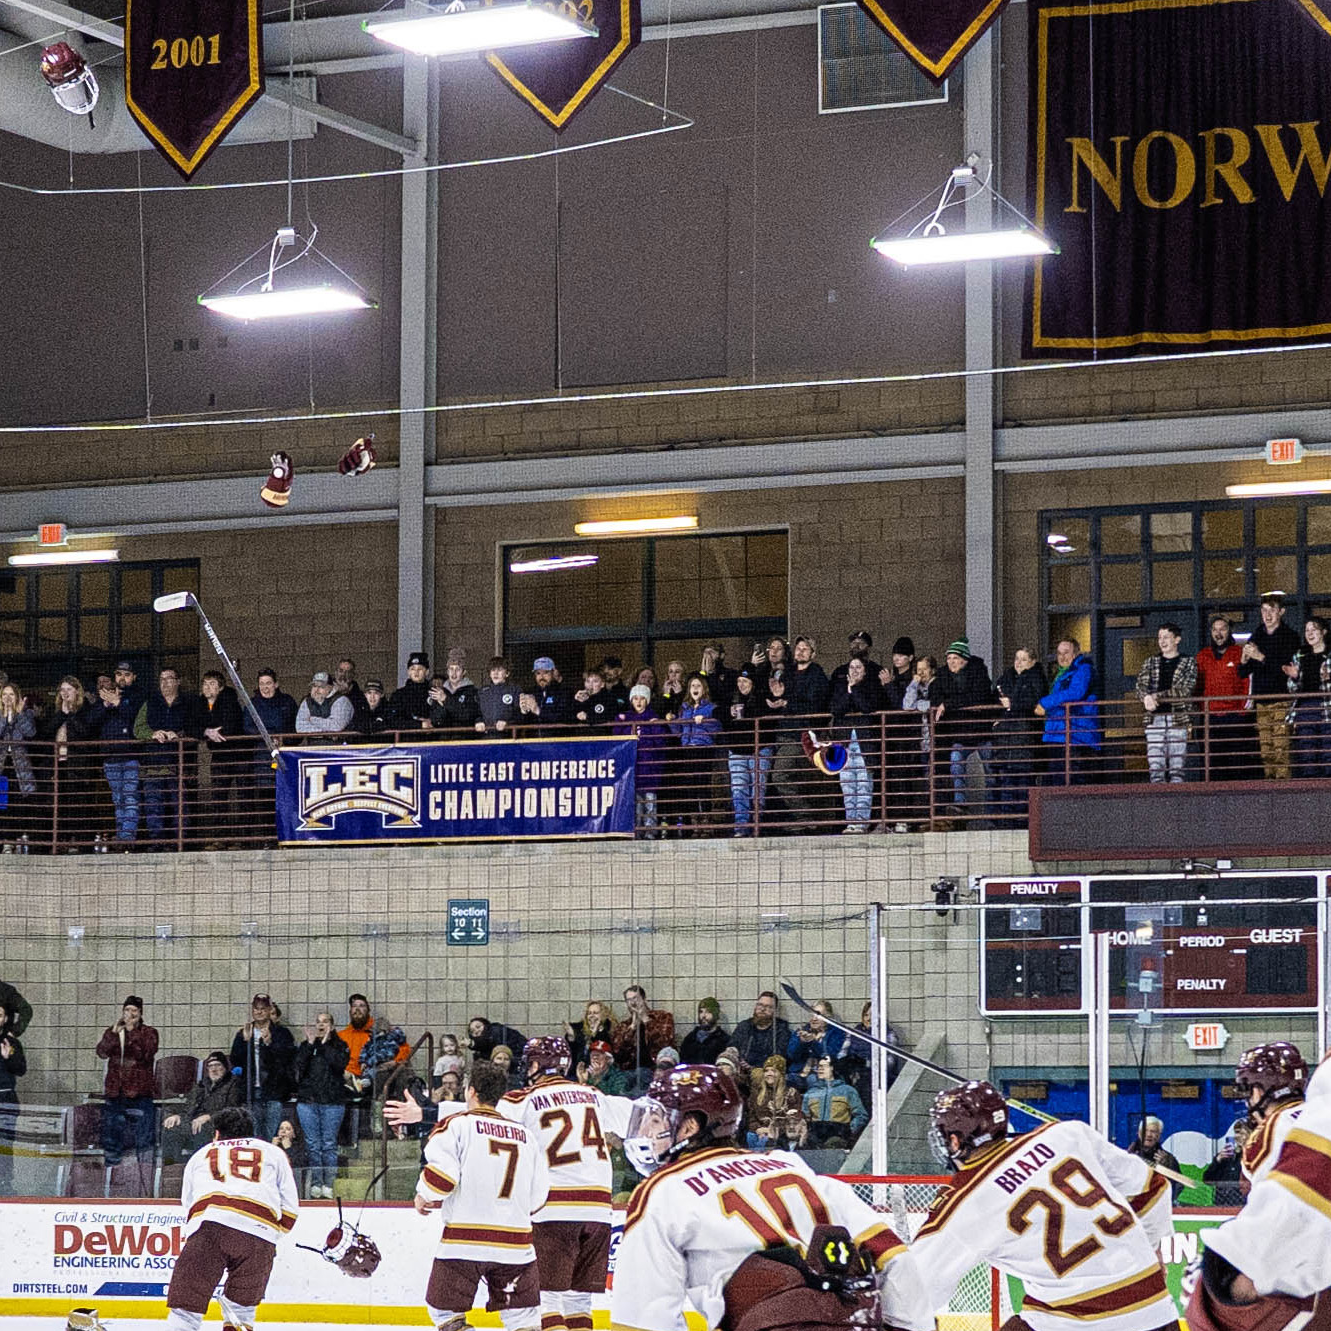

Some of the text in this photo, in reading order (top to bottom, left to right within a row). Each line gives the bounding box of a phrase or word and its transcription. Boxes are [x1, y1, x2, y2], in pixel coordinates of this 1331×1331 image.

[151, 34, 221, 70] 2001
[1272, 442, 1295, 461] EXIT
[430, 759, 615, 783] LITTLE EAST CONFERENCE
[306, 764, 413, 804] LEC
[429, 786, 615, 820] CHAMPIONSHIP
[1011, 883, 1058, 896] PENALTY
[451, 907, 486, 916] Section
[454, 918, 482, 927] 10 11
[1109, 931, 1151, 945] HOME
[1180, 935, 1224, 948] PERIOD
[1250, 928, 1303, 943] GUEST
[1177, 979, 1226, 991] PENALTY
[1194, 1026, 1219, 1047] EXIT
[532, 1095, 551, 1110] VAN
[476, 1120, 527, 1144] CORDEIRO
[540, 1107, 608, 1168] 24
[205, 1147, 264, 1183] 18
[488, 1140, 519, 1199] 7
[994, 1142, 1056, 1195] BRAZO
[684, 1159, 794, 1196] D'ANCONA
[54, 1211, 188, 1226] Civil & Structural Enginee
[717, 1172, 832, 1260] 10
[1007, 1156, 1136, 1280] 29
[54, 1224, 184, 1256] DeWol
[54, 1256, 141, 1268] ENGINEERING
[13, 1283, 87, 1294] DIRTSTEEL.COM
